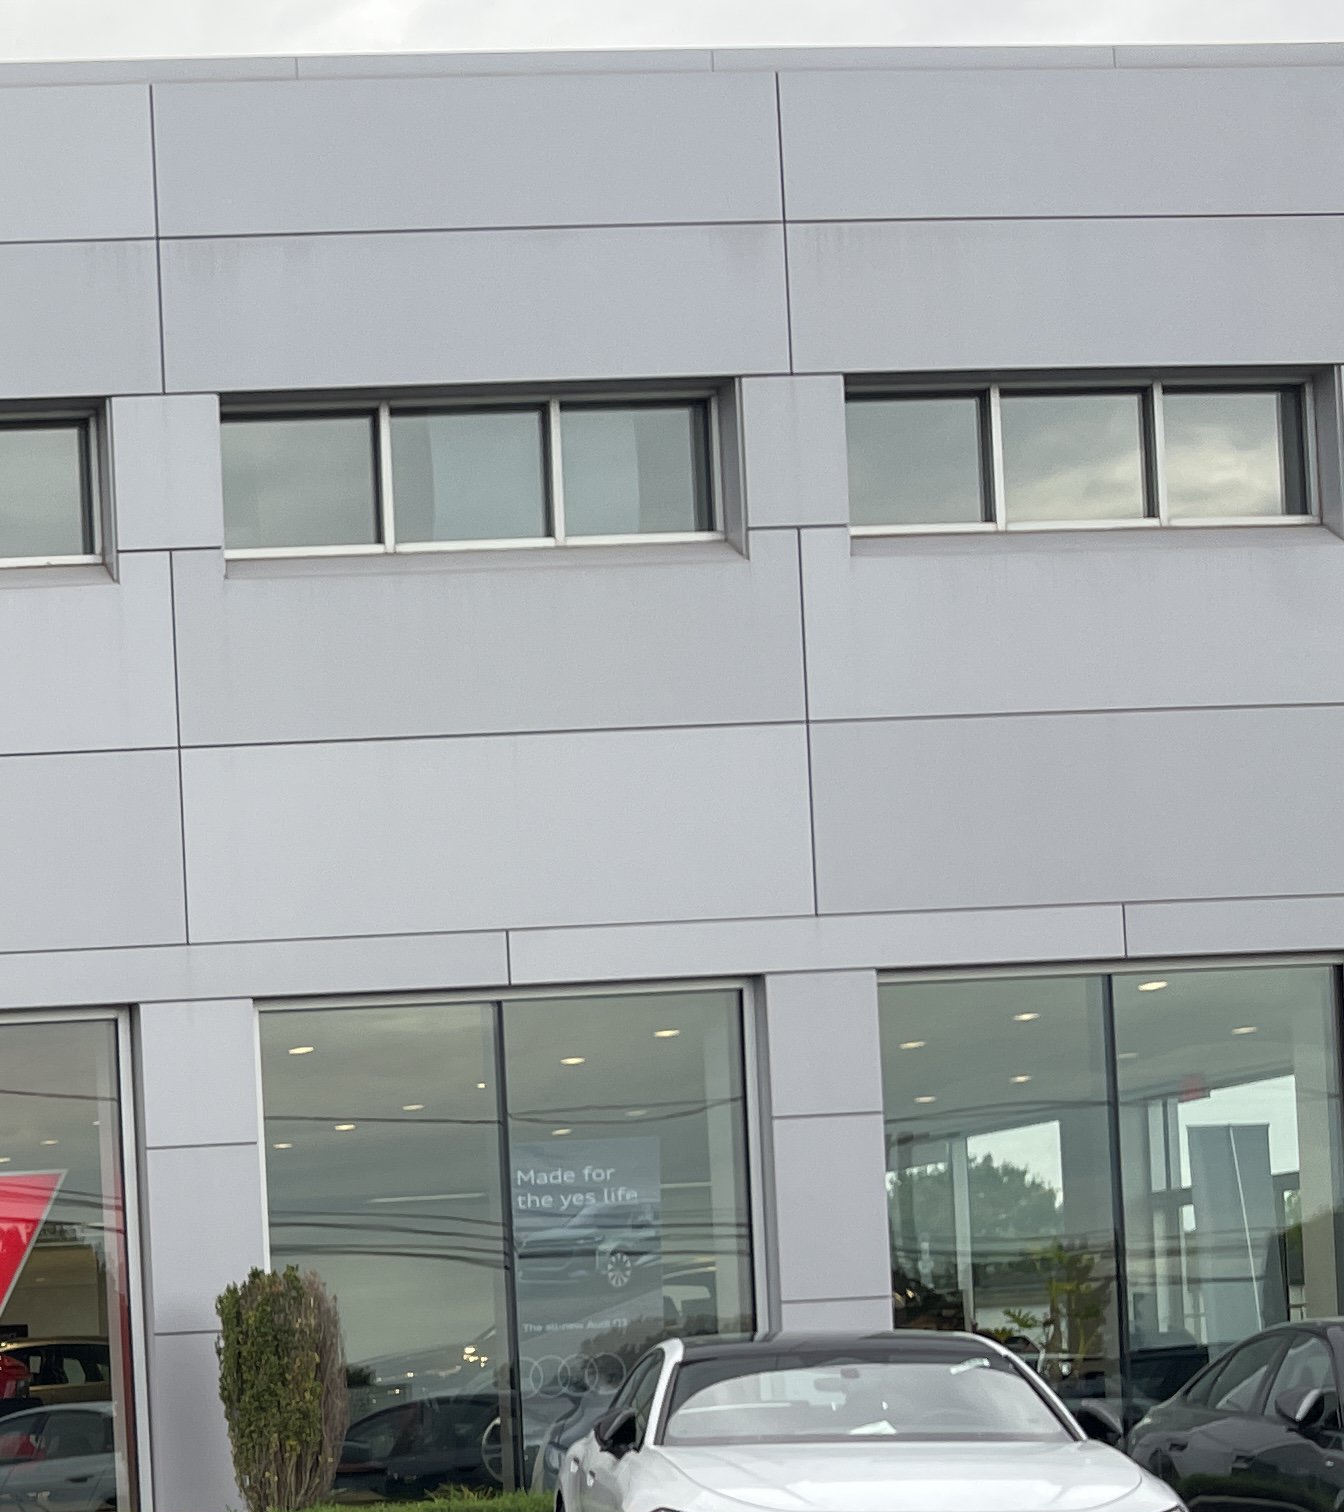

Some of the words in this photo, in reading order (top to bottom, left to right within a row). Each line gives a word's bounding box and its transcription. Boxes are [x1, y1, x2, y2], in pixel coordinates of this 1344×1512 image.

[517, 1168, 575, 1185] Made
[582, 1165, 615, 1182] for
[518, 1192, 553, 1209] the
[560, 1191, 596, 1211] yes
[603, 1187, 638, 1205] life
[522, 1323, 543, 1333] The
